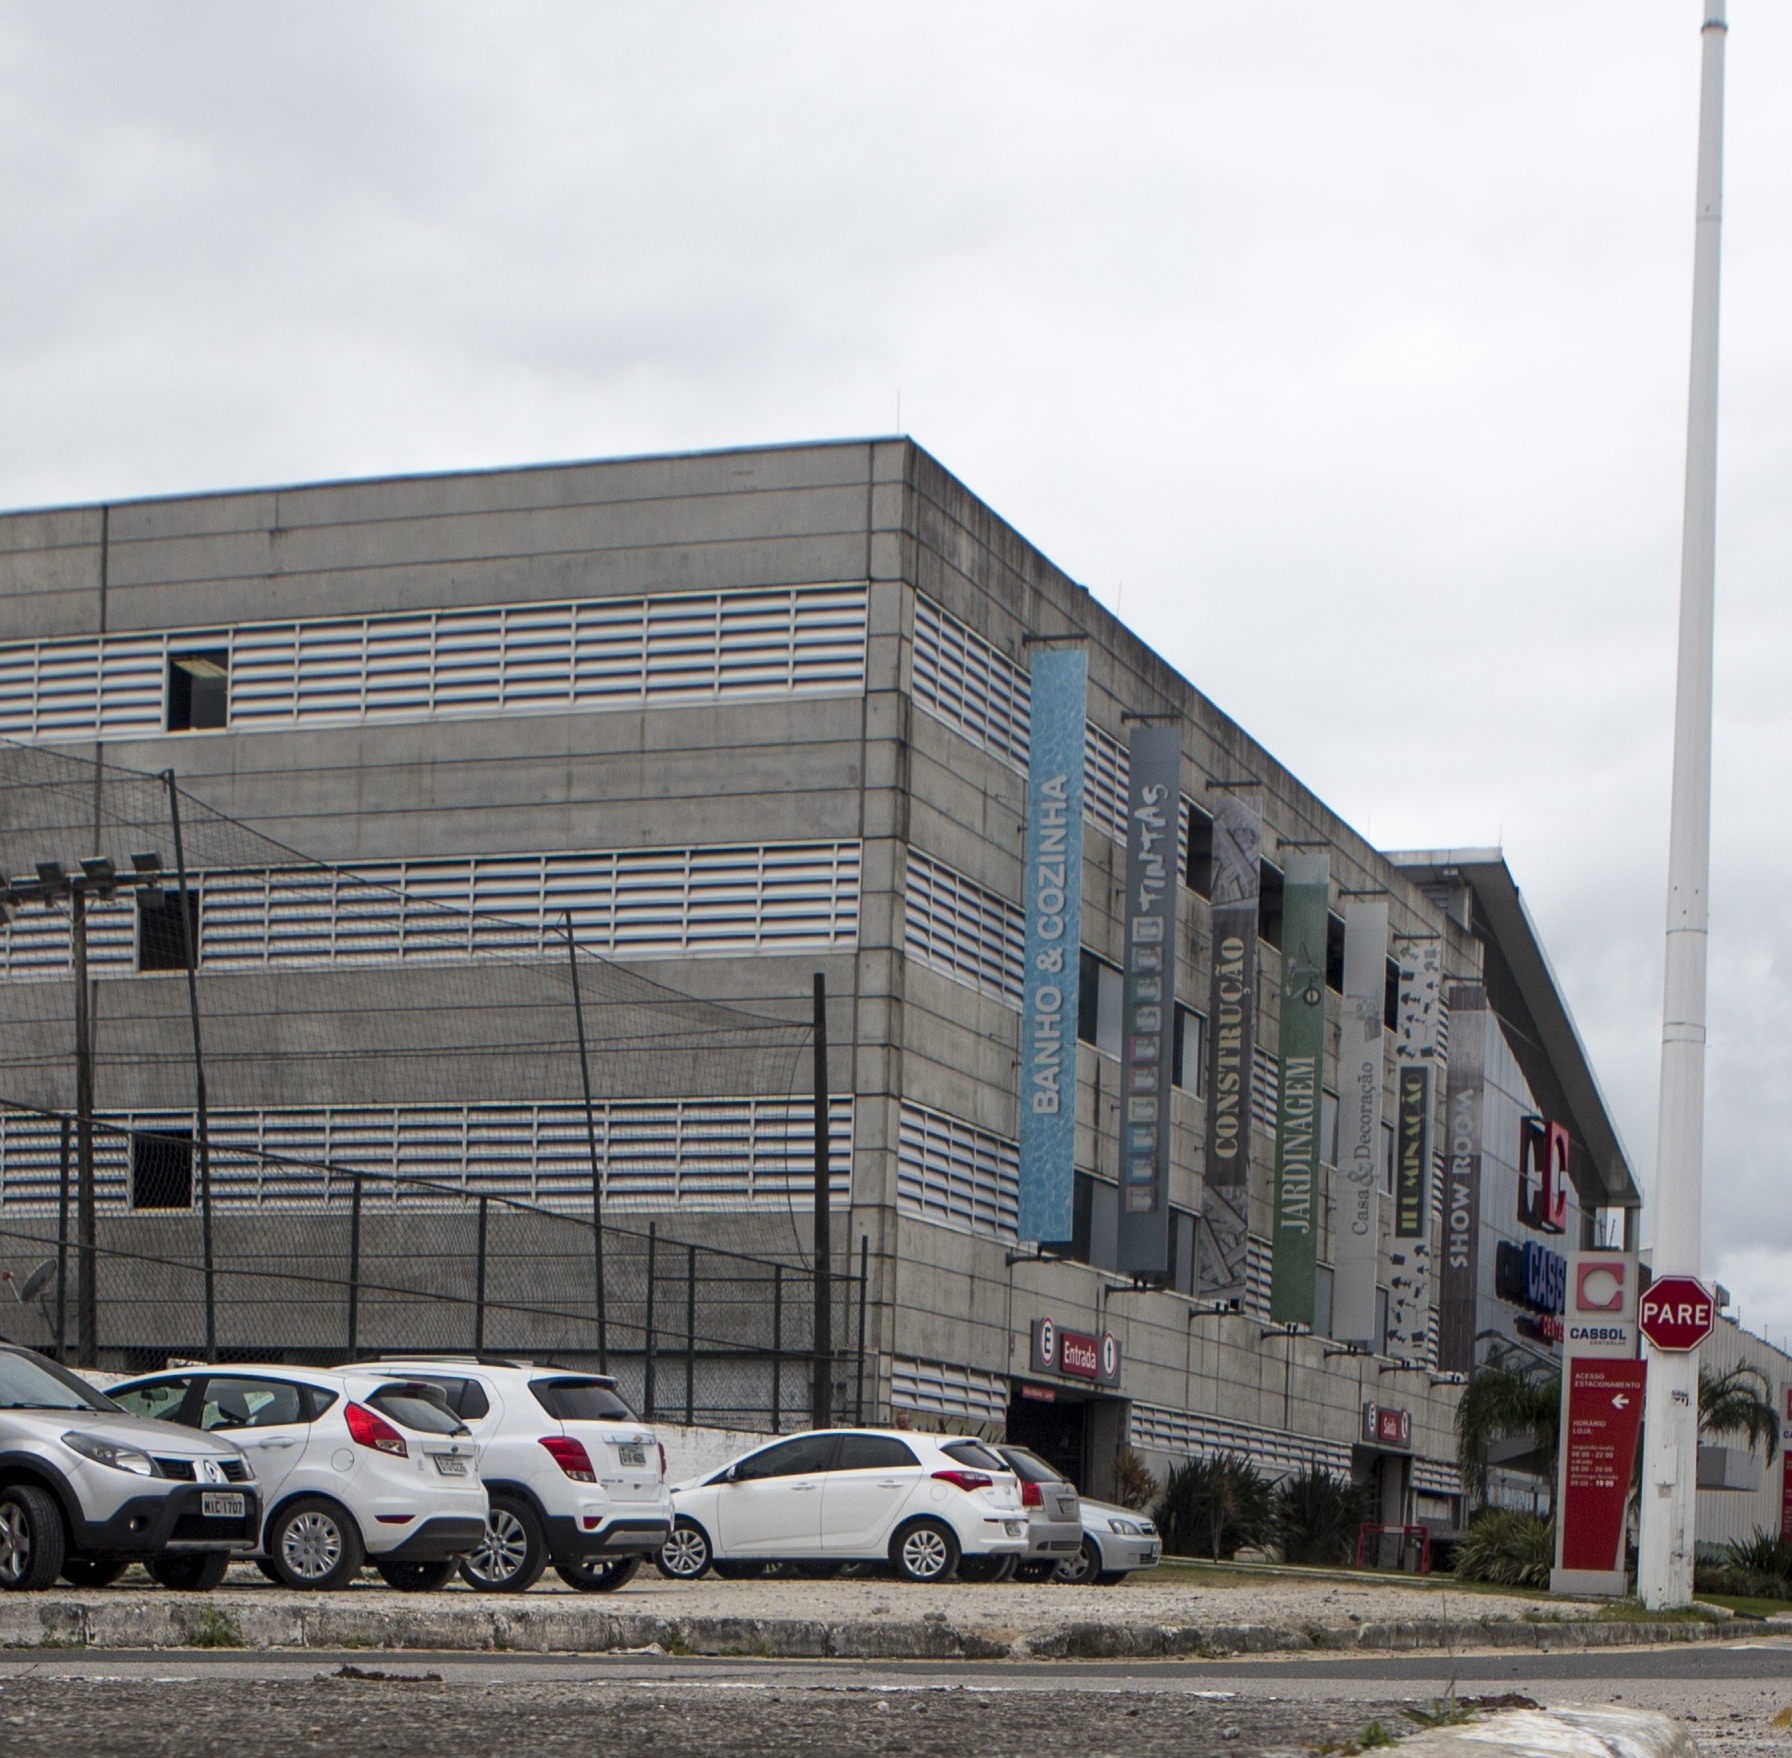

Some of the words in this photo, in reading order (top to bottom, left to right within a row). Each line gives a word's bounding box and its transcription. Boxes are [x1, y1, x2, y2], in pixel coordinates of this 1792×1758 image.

[1035, 772, 1069, 942] COZINHA
[1138, 782, 1169, 913] TINTAS
[1035, 945, 1065, 976] &
[1031, 984, 1064, 1117] BANHO
[1214, 936, 1251, 1160] CONSTRUÇÃO
[1279, 1055, 1316, 1235] JARDINAGEM
[1451, 1088, 1475, 1179] ROOM
[1448, 1182, 1471, 1269] SHOW
[1522, 1240, 1567, 1315] CASS
[1643, 1302, 1709, 1326] PARE
[1064, 1341, 1097, 1370] Entrada
[1570, 1327, 1627, 1340] CASSOL
[1574, 1380, 1641, 1389] ESTACIONAMENTO
